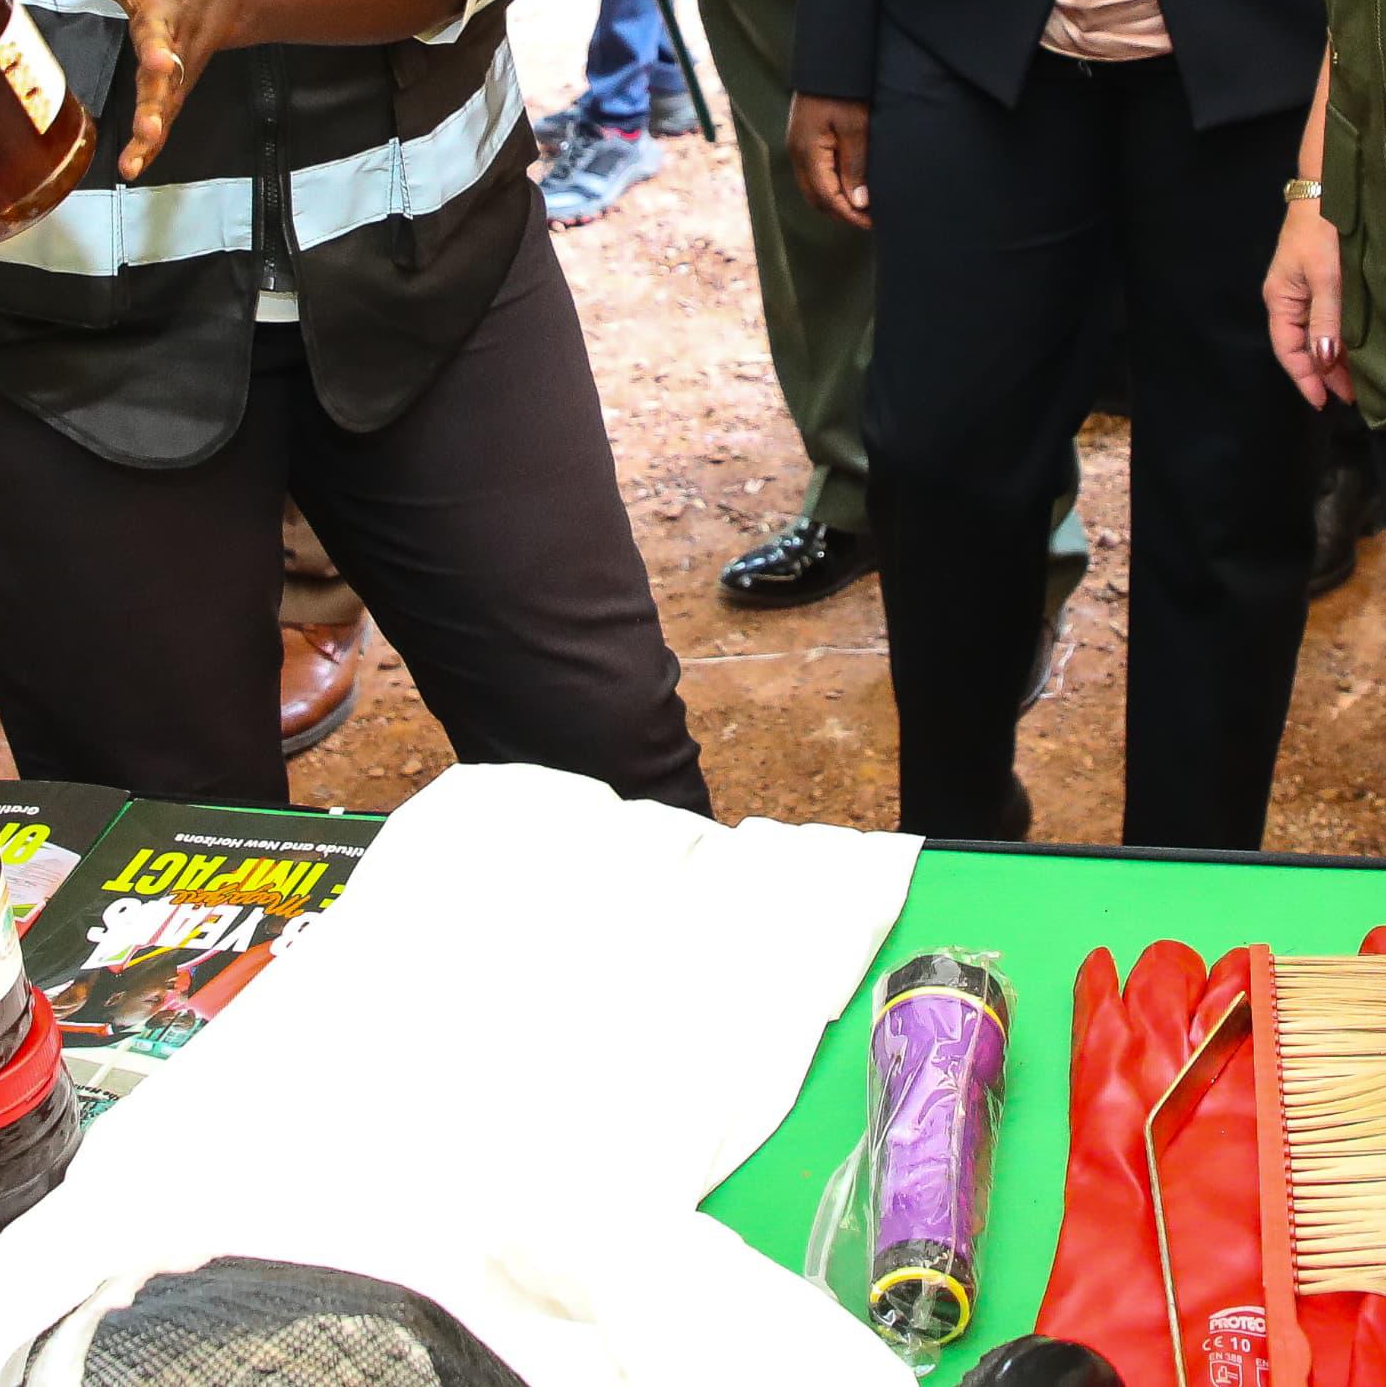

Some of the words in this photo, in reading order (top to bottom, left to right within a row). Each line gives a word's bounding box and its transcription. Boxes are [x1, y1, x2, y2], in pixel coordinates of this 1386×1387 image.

[174, 832, 243, 849] Horizons
[243, 839, 279, 852] New
[280, 840, 315, 853] and
[315, 843, 366, 858] titude
[101, 848, 330, 899] IMPACT
